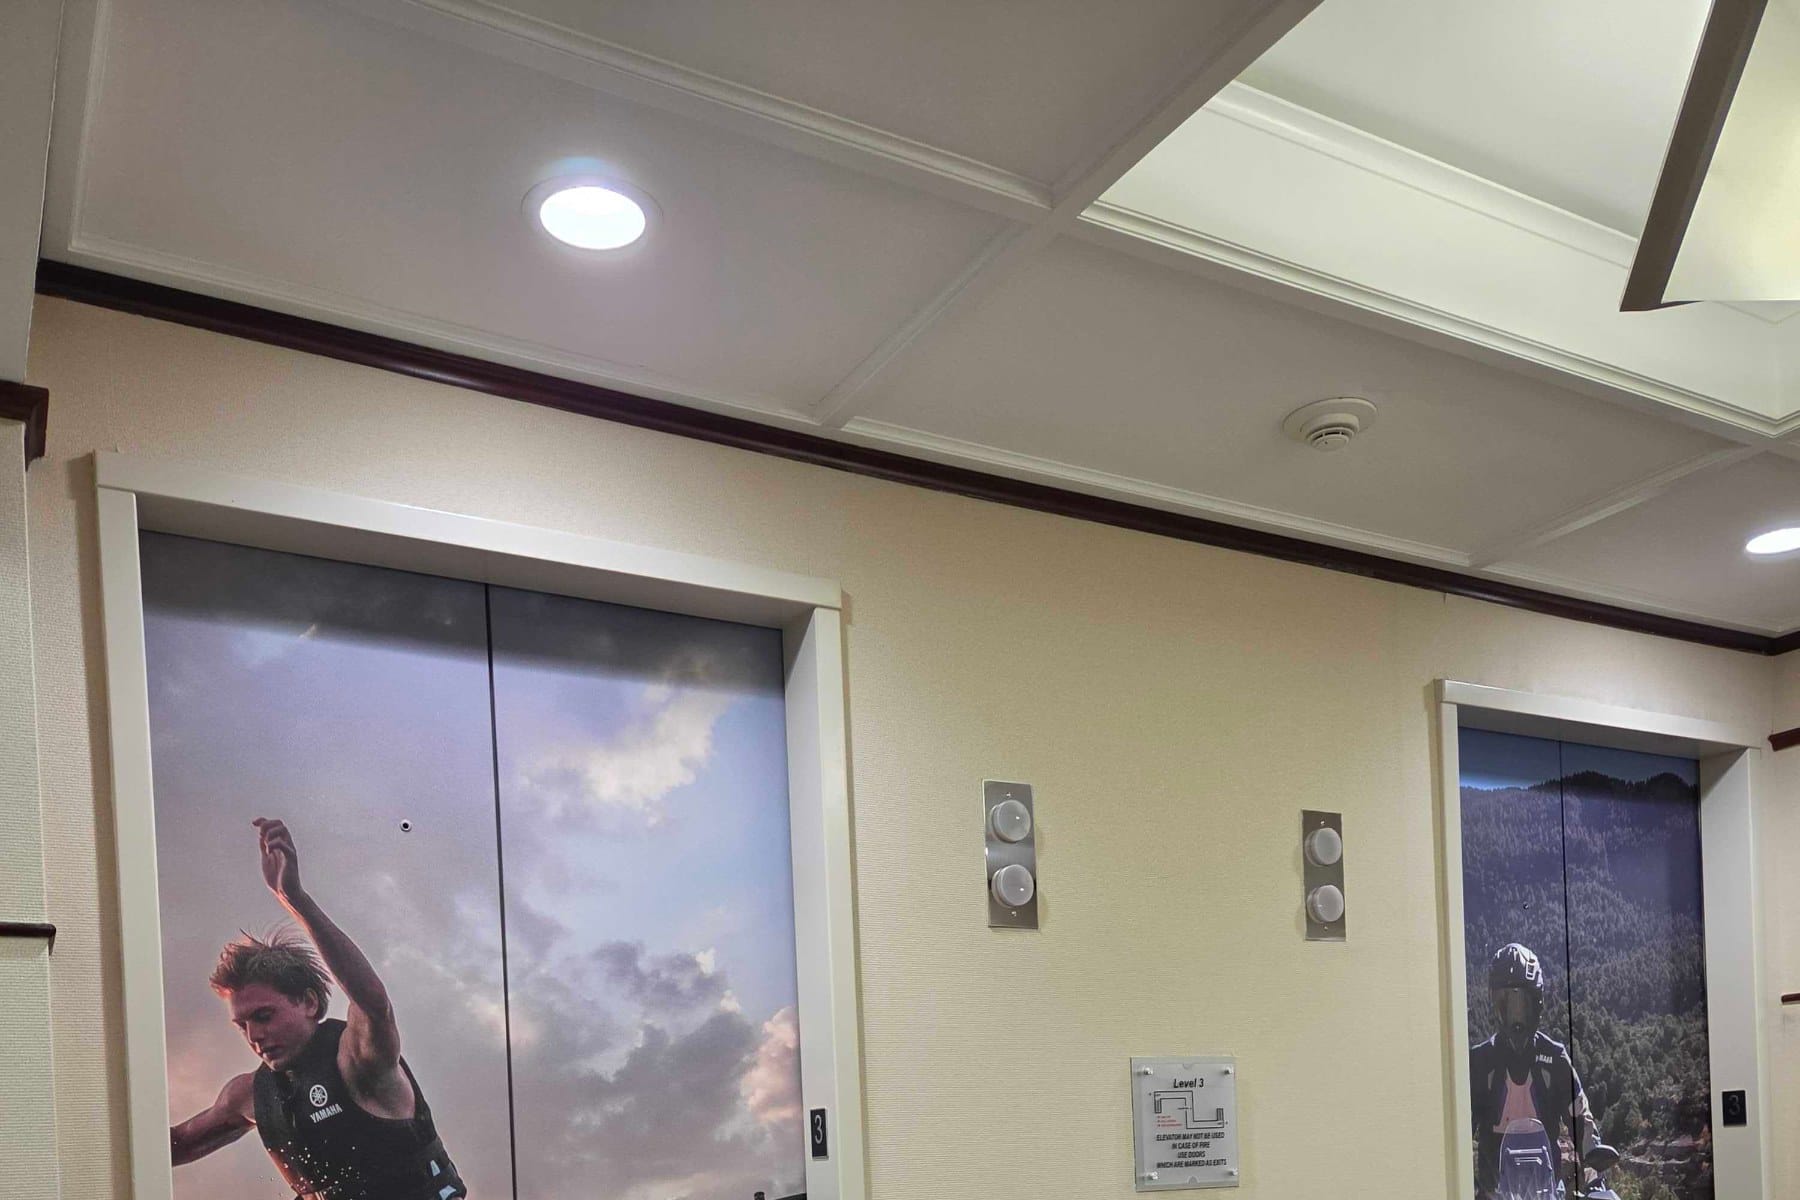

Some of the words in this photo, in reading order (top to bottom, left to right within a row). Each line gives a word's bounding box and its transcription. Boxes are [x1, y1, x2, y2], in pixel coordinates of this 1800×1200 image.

[1173, 1078, 1197, 1088] Level
[1199, 1077, 1204, 1088] 3
[309, 1103, 343, 1123] YAMAHA
[1729, 1095, 1740, 1116] 3
[814, 1114, 823, 1144] 3
[1156, 1133, 1181, 1141] ELEVATOR
